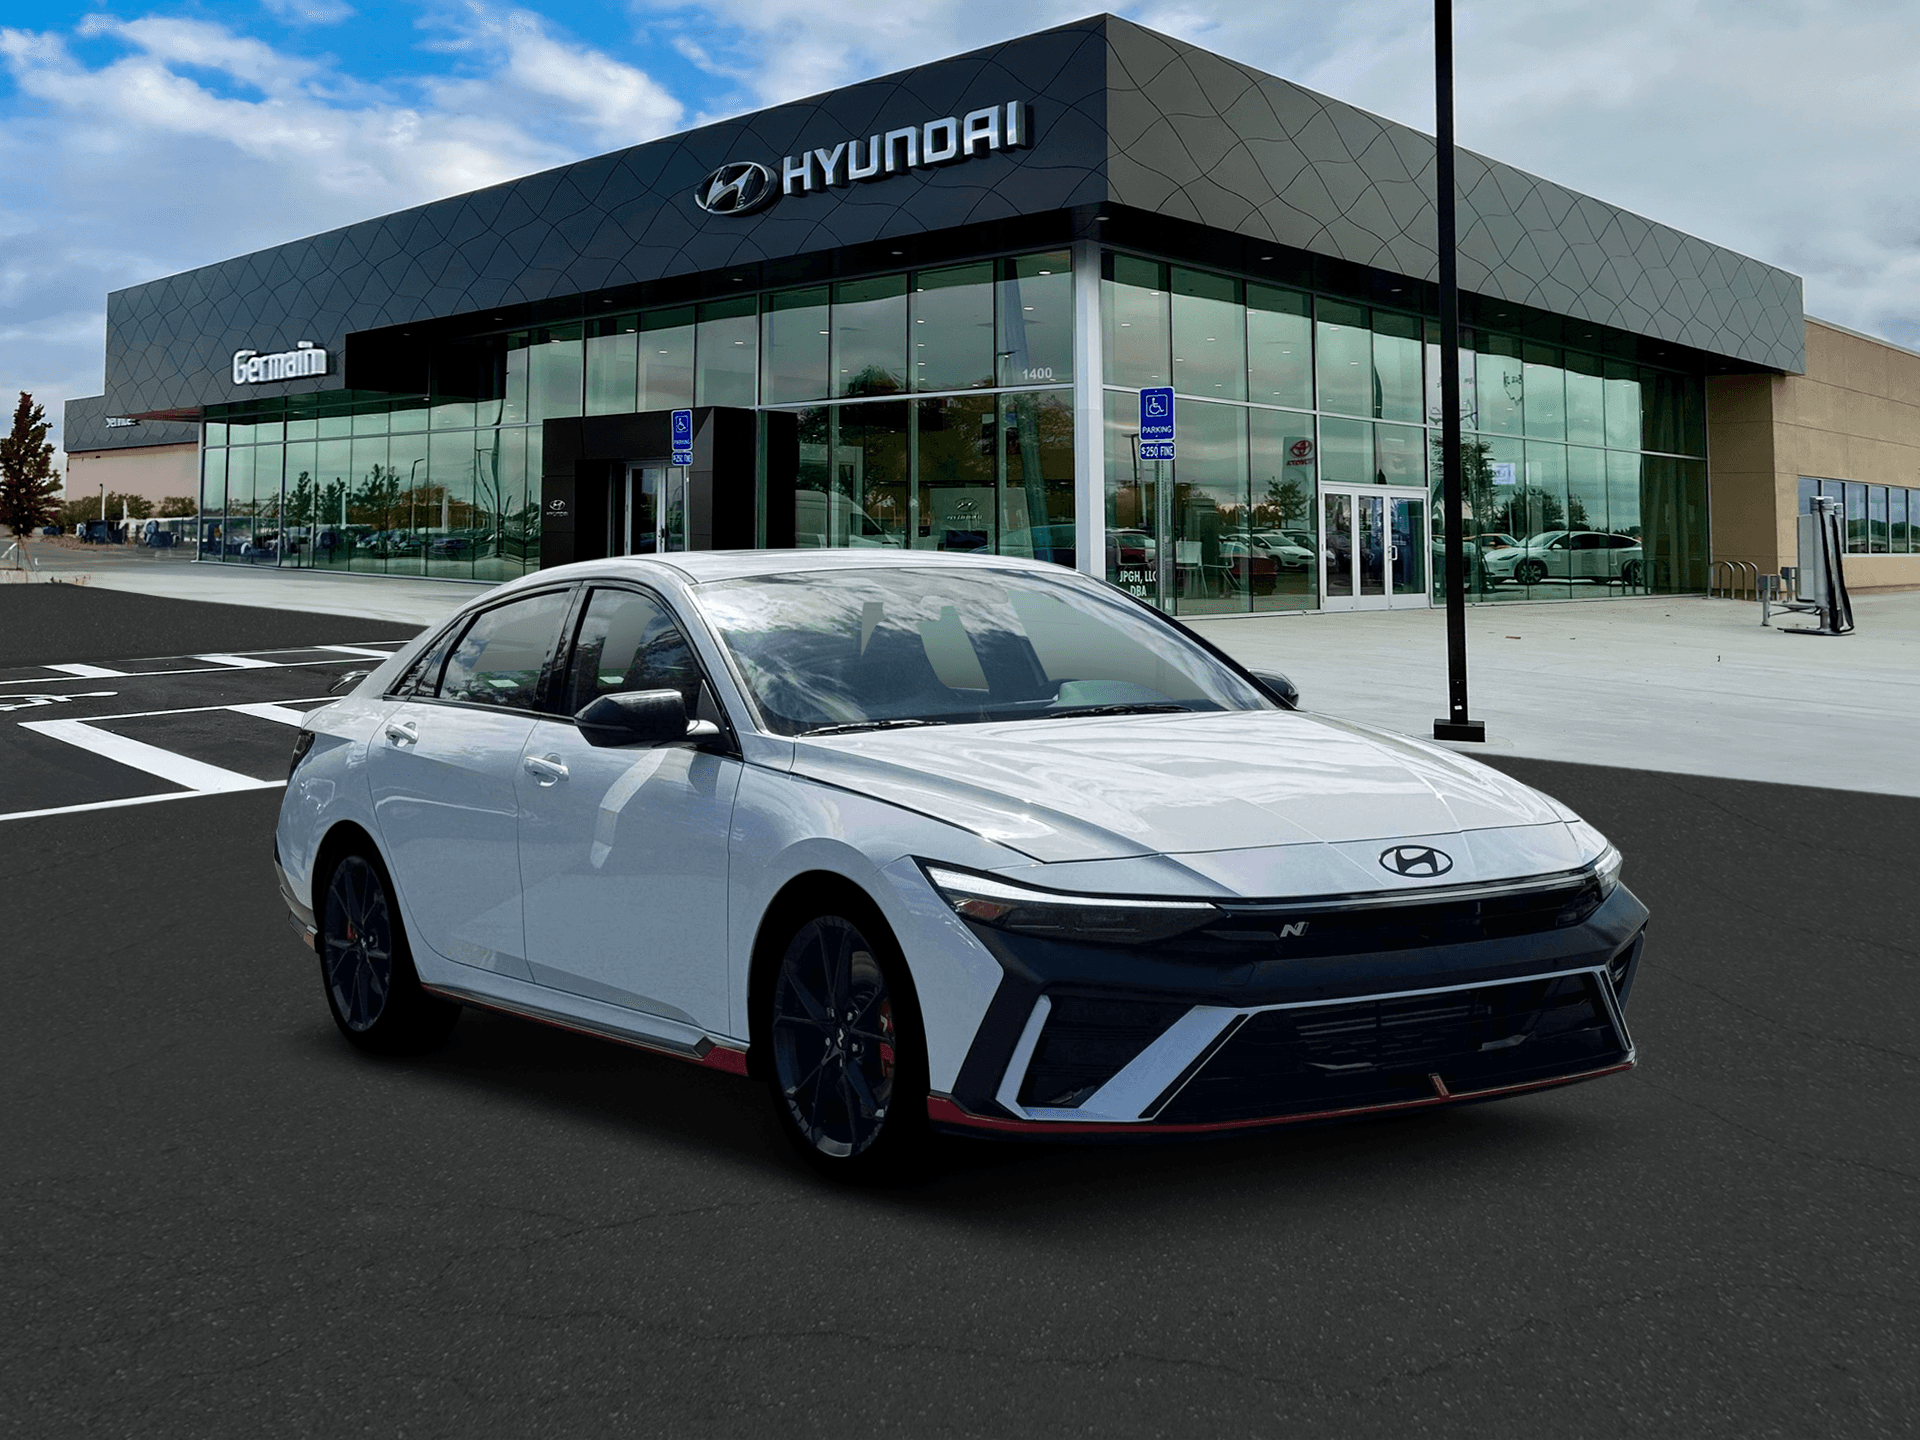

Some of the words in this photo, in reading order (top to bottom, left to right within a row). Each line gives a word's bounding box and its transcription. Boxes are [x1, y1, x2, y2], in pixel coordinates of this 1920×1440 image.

[783, 100, 1025, 195] HYUNDAI
[233, 341, 327, 385] Germain
[1022, 367, 1053, 380] 1400
[1142, 425, 1172, 434] PARKING
[1160, 445, 1174, 457] FINE
[1119, 570, 1143, 584] JPGH,
[1130, 585, 1147, 597] DBA
